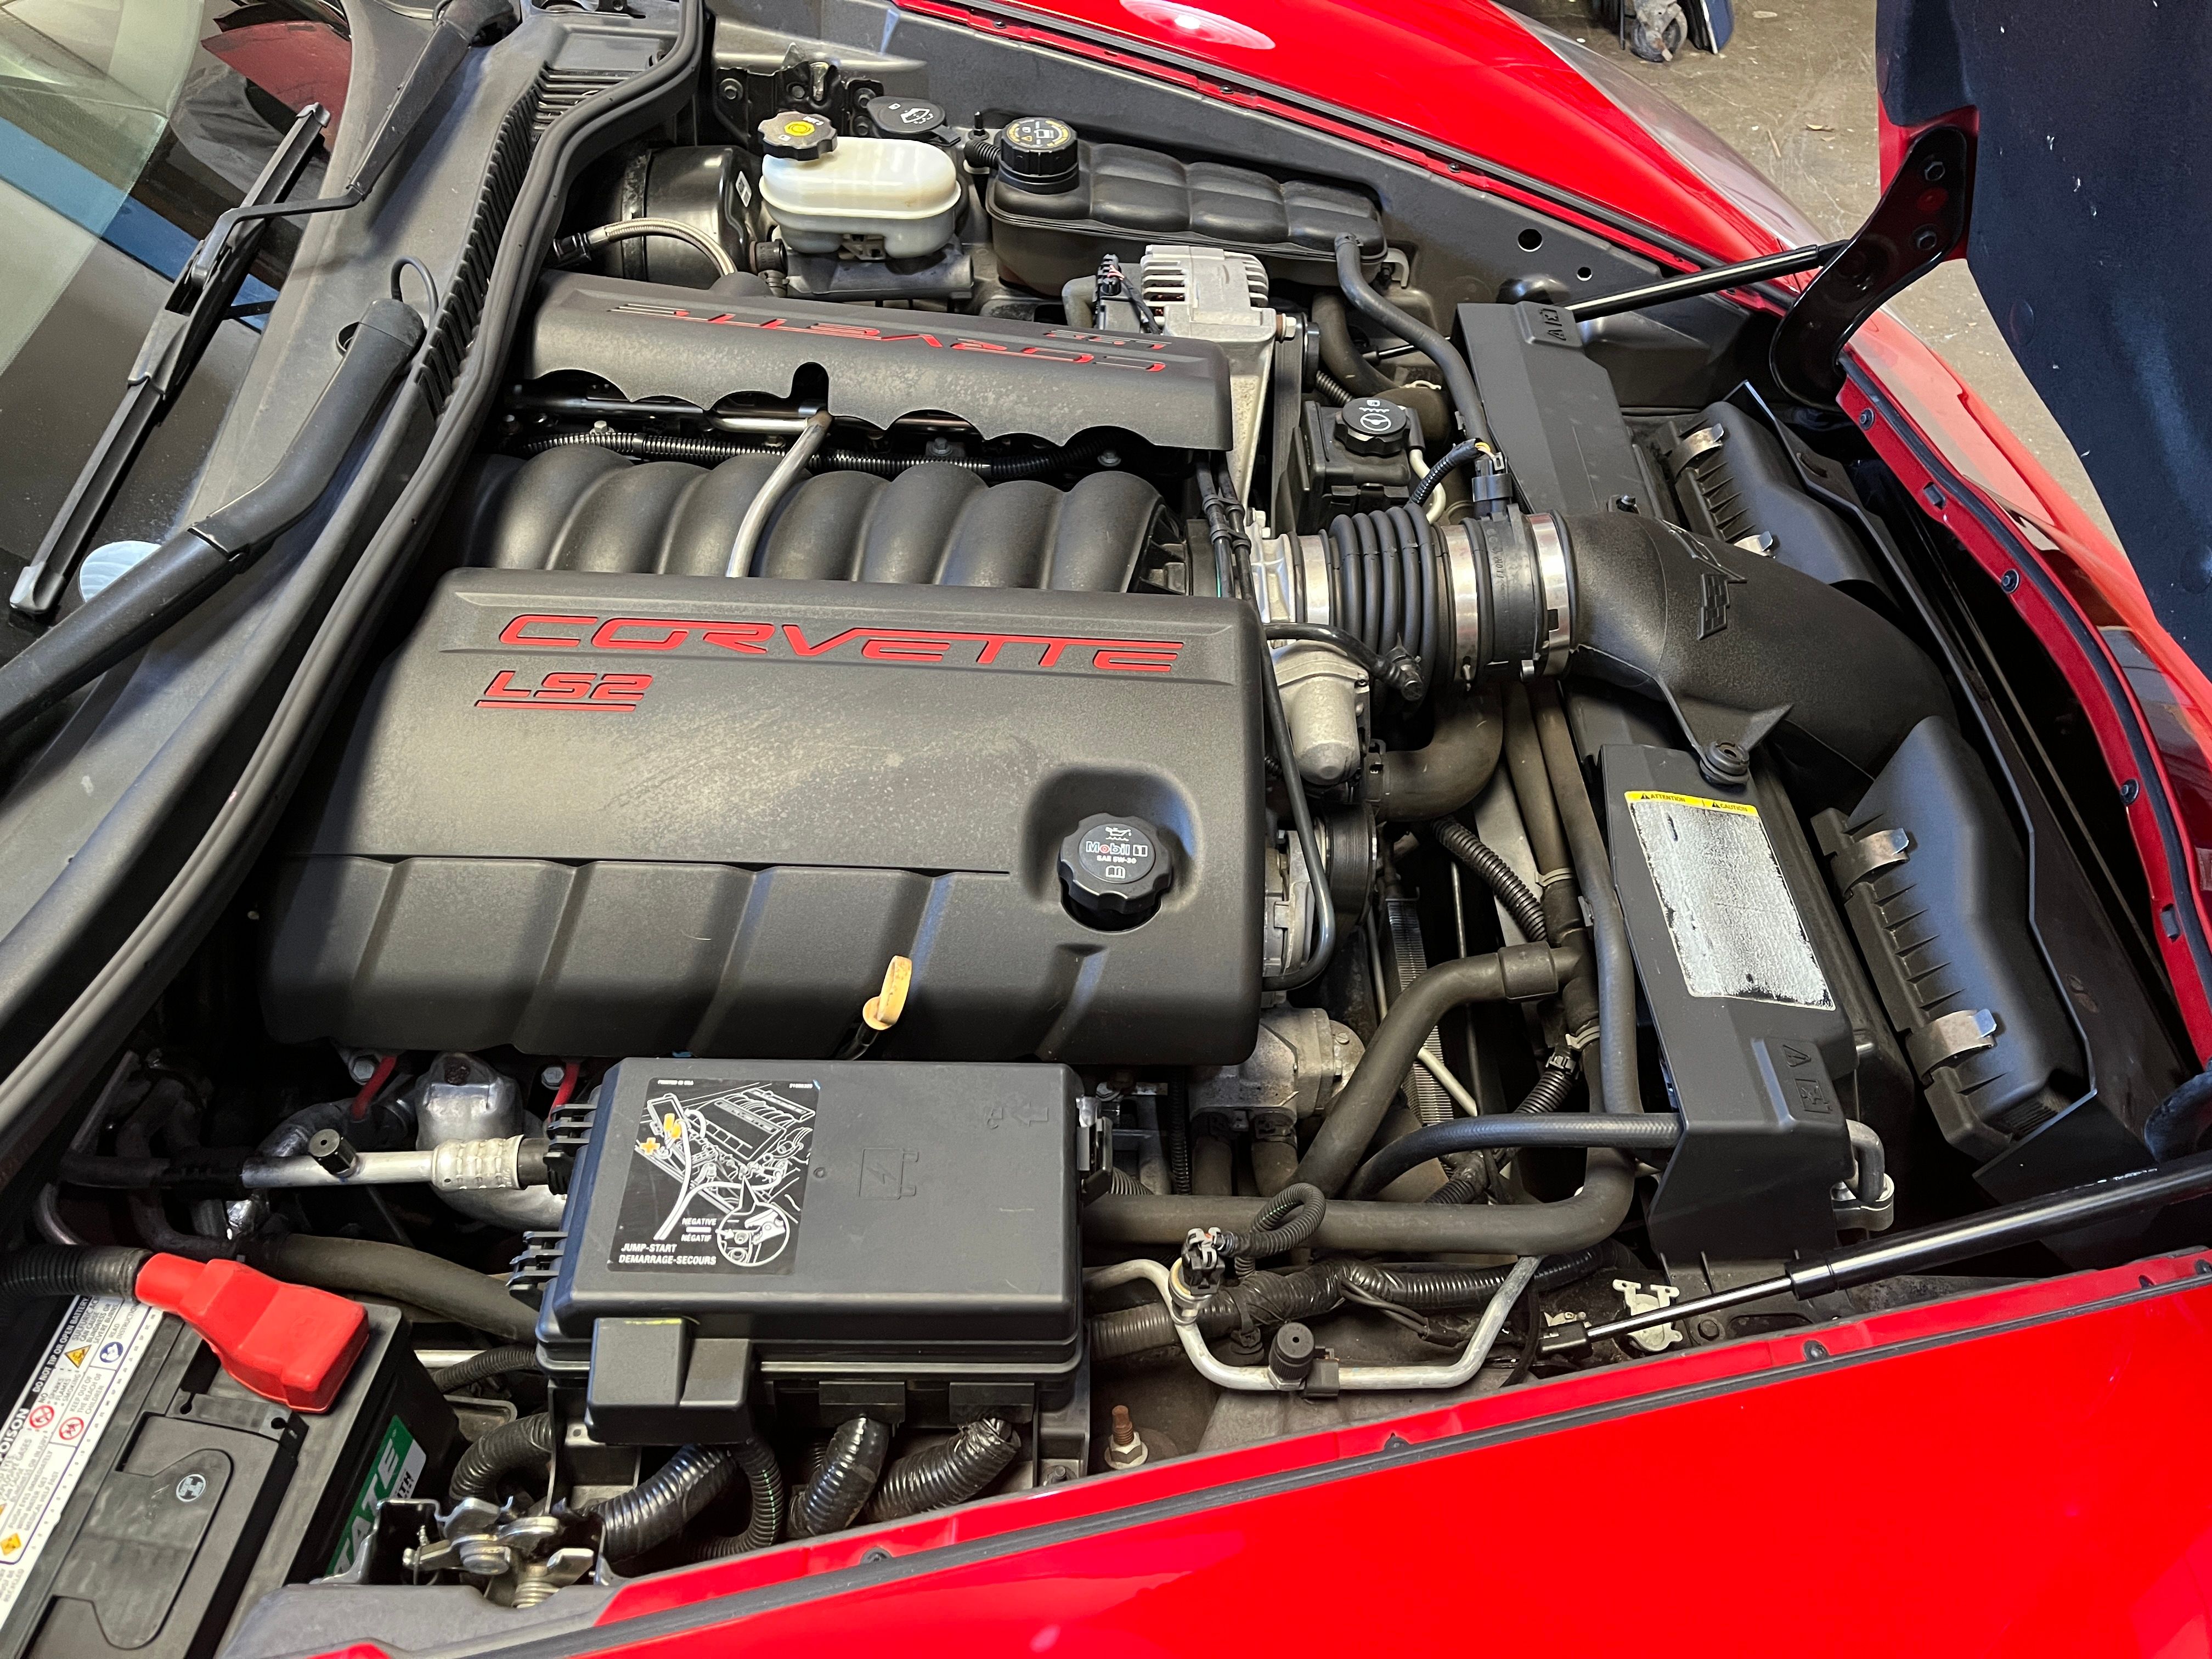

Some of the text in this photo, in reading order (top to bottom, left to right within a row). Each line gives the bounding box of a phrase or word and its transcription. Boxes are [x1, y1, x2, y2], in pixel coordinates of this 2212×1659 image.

[499, 614, 1184, 673] CORVETTE
[485, 671, 653, 701] LS2
[1650, 794, 1686, 802] ATTENTION
[1719, 804, 1747, 812] CAUTION
[1085, 840, 1131, 856] Mobil
[1097, 854, 1111, 862] SAE
[681, 1217, 717, 1226] NEGATIVE
[620, 1243, 678, 1252] JUMP-START
[618, 1254, 717, 1266] DEMARRAGE-SECOURS
[71, 1310, 93, 1341] SULFURIC
[32, 1381, 44, 1392] DO
[38, 1366, 52, 1380] NOT
[47, 1355, 58, 1364] TIP
[53, 1344, 64, 1353] OR
[59, 1325, 75, 1342] OPEN
[0, 1407, 30, 1462] OISON
